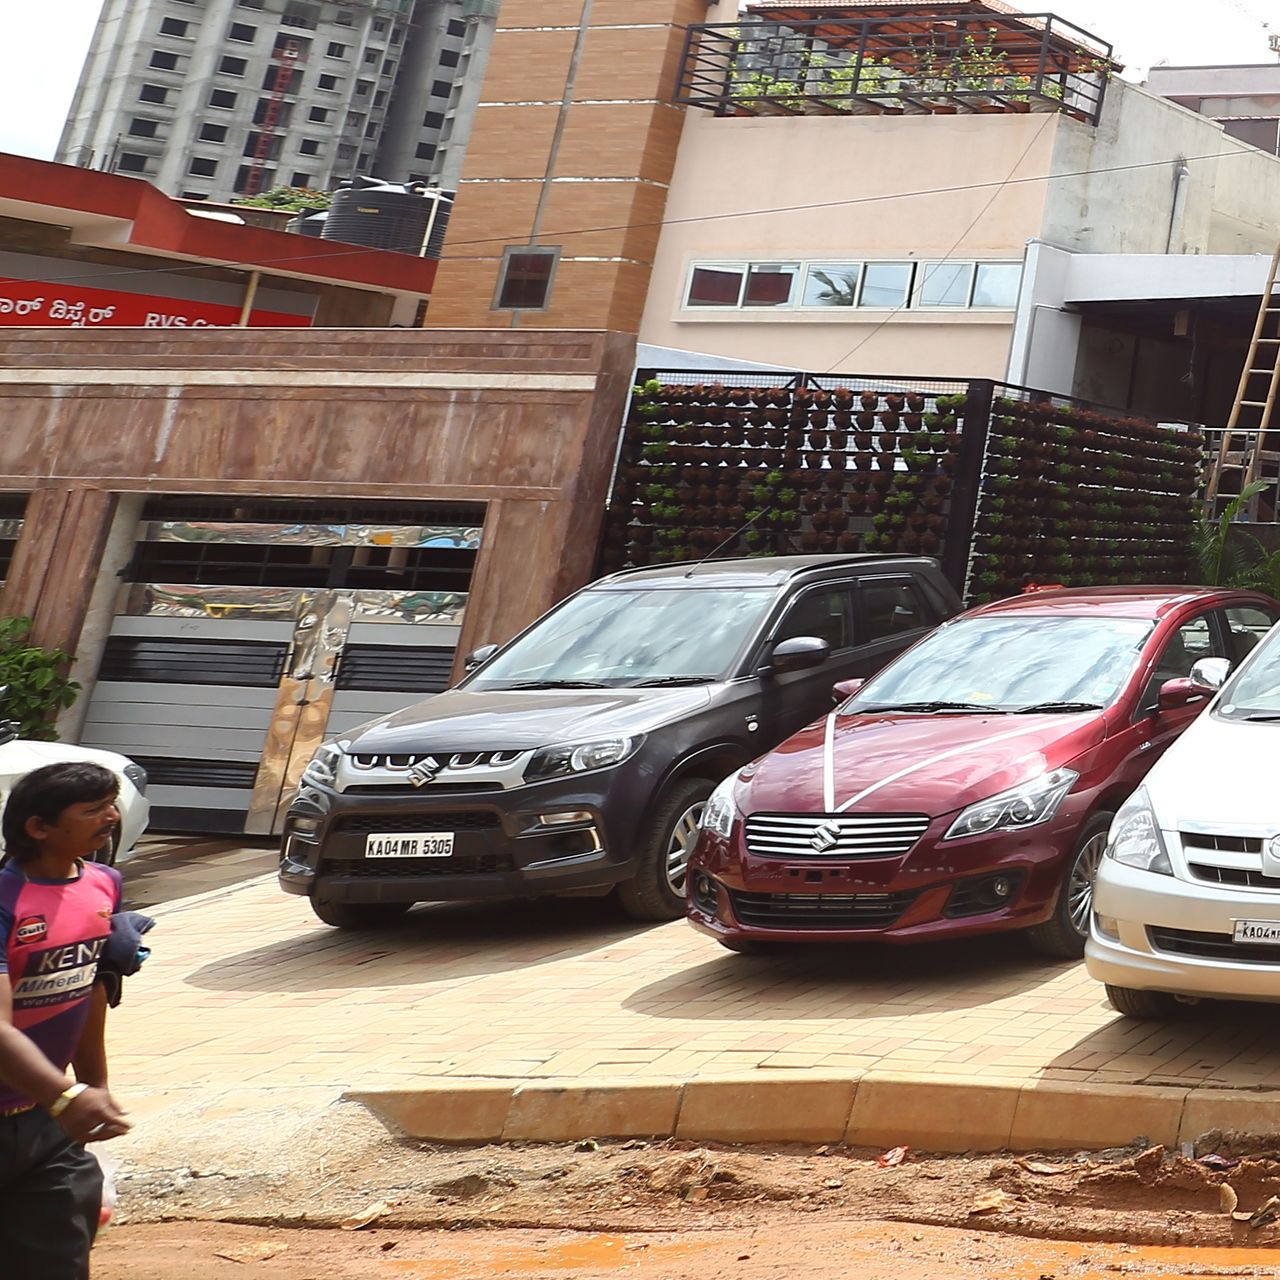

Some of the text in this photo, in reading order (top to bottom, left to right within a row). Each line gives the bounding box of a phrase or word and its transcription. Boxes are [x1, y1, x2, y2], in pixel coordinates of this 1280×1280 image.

[423, 839, 452, 854] 5305
[18, 924, 46, 936] Gulf
[16, 971, 85, 993] Mineral
